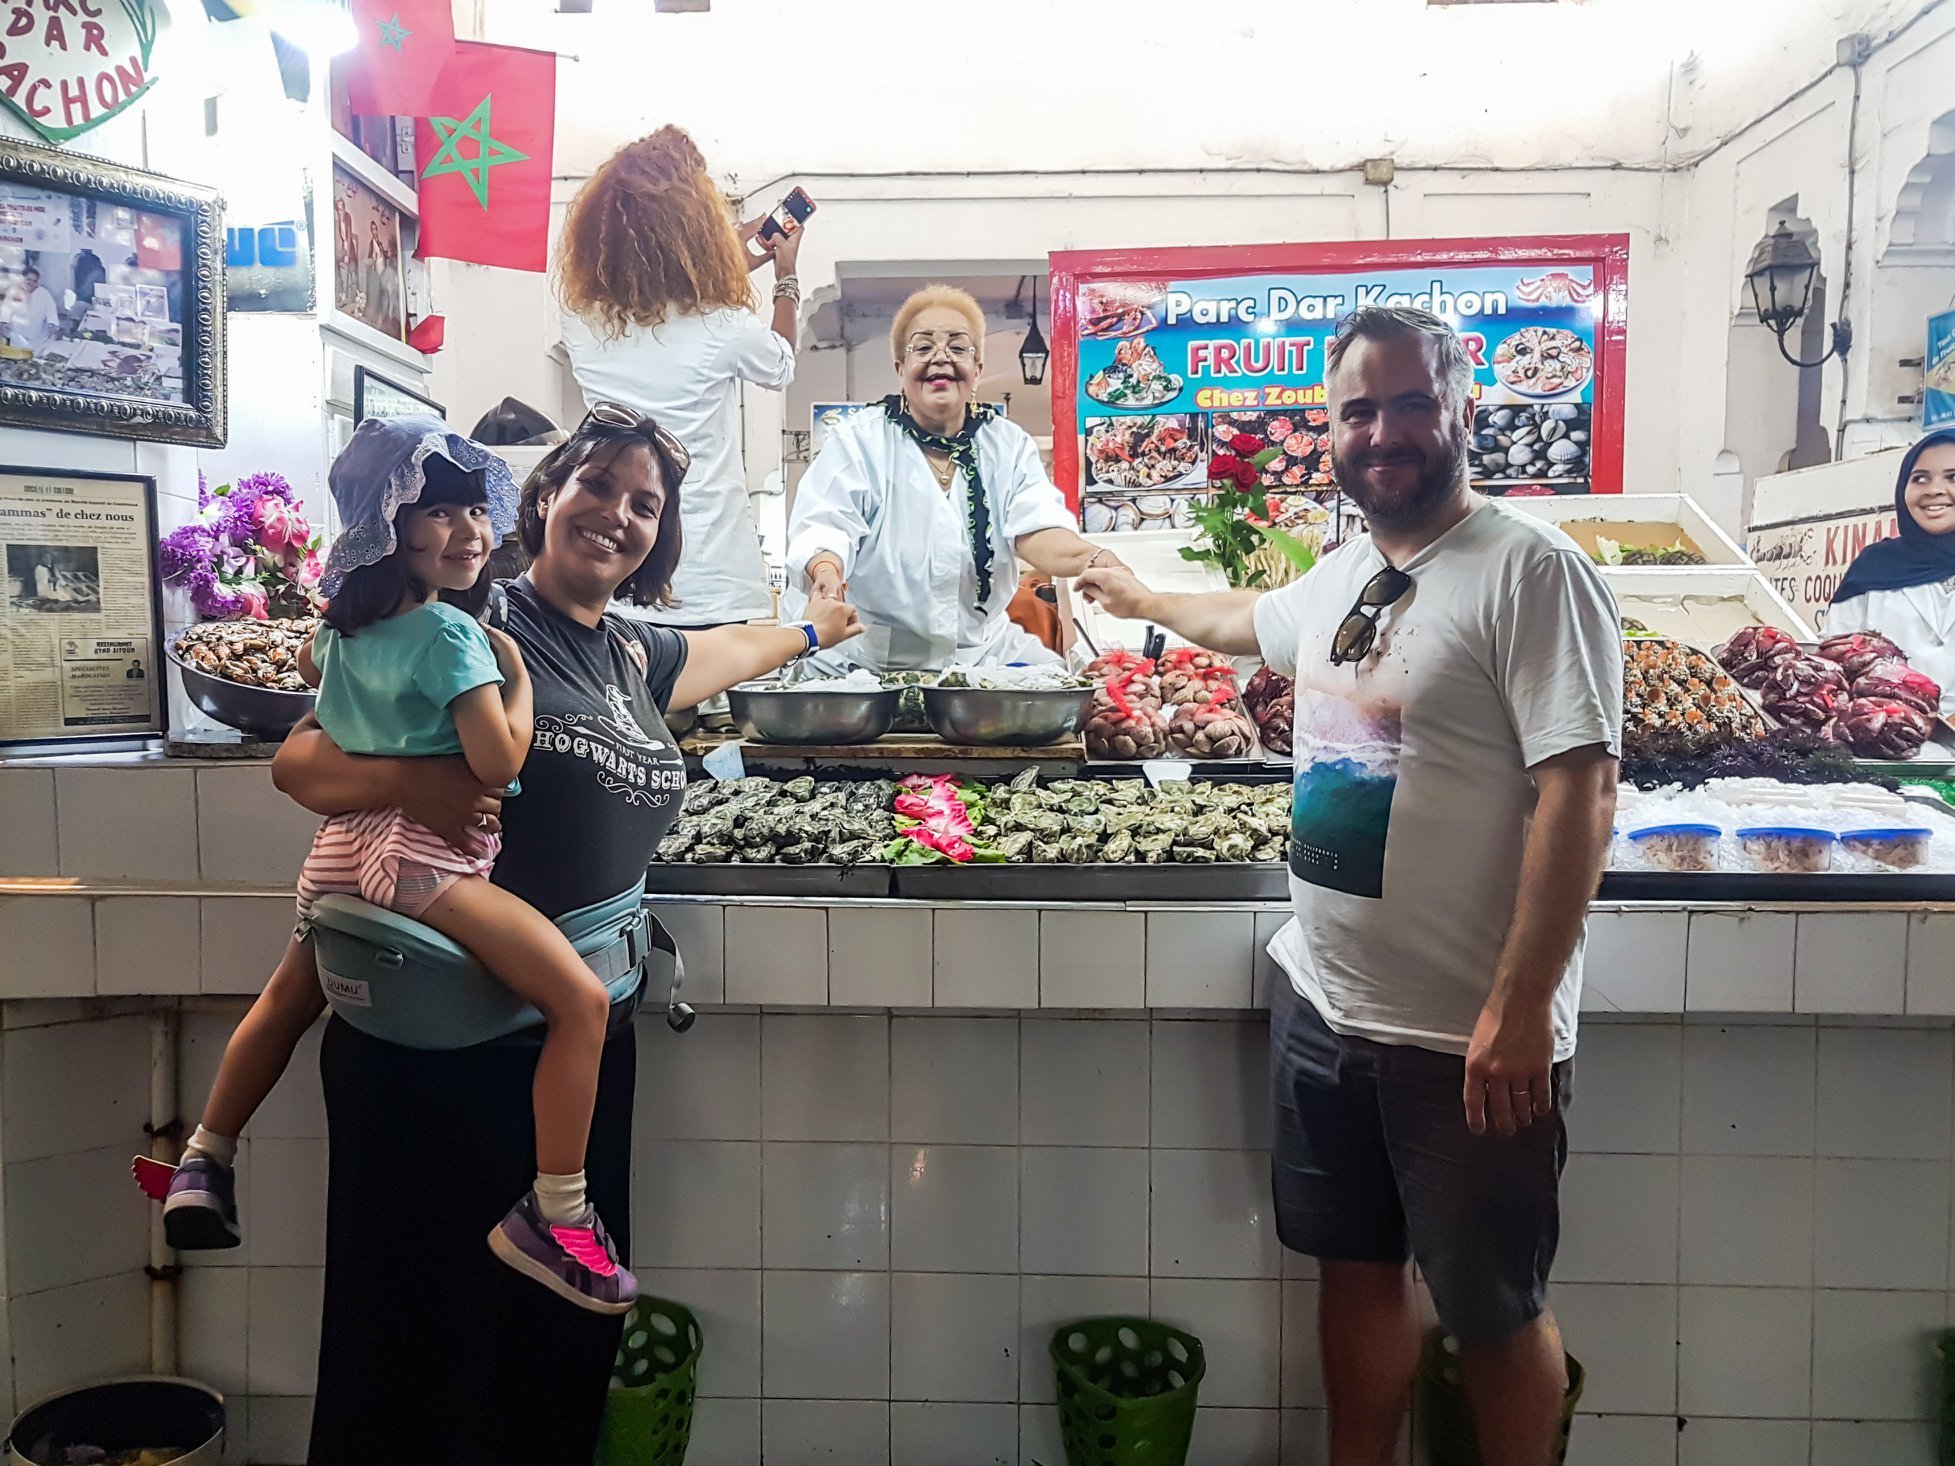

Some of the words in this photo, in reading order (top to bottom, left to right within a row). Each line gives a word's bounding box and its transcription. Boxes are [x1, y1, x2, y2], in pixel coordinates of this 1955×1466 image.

[6, 7, 109, 57] DAR
[0, 48, 145, 127] ACHON
[1166, 289, 1257, 326] Parc
[1268, 287, 1345, 322] Dar
[1355, 280, 1508, 318] Kachon
[1188, 337, 1313, 378] FRUIT
[1195, 386, 1259, 408] Chez
[1262, 384, 1328, 406] Zoub
[56, 509, 71, 520] de
[74, 510, 102, 521] chez
[105, 513, 135, 522] nous
[1824, 518, 1898, 567] KINA
[533, 730, 647, 787] HOGWARTS
[616, 742, 635, 759] FIRST
[636, 752, 660, 765] YEAR
